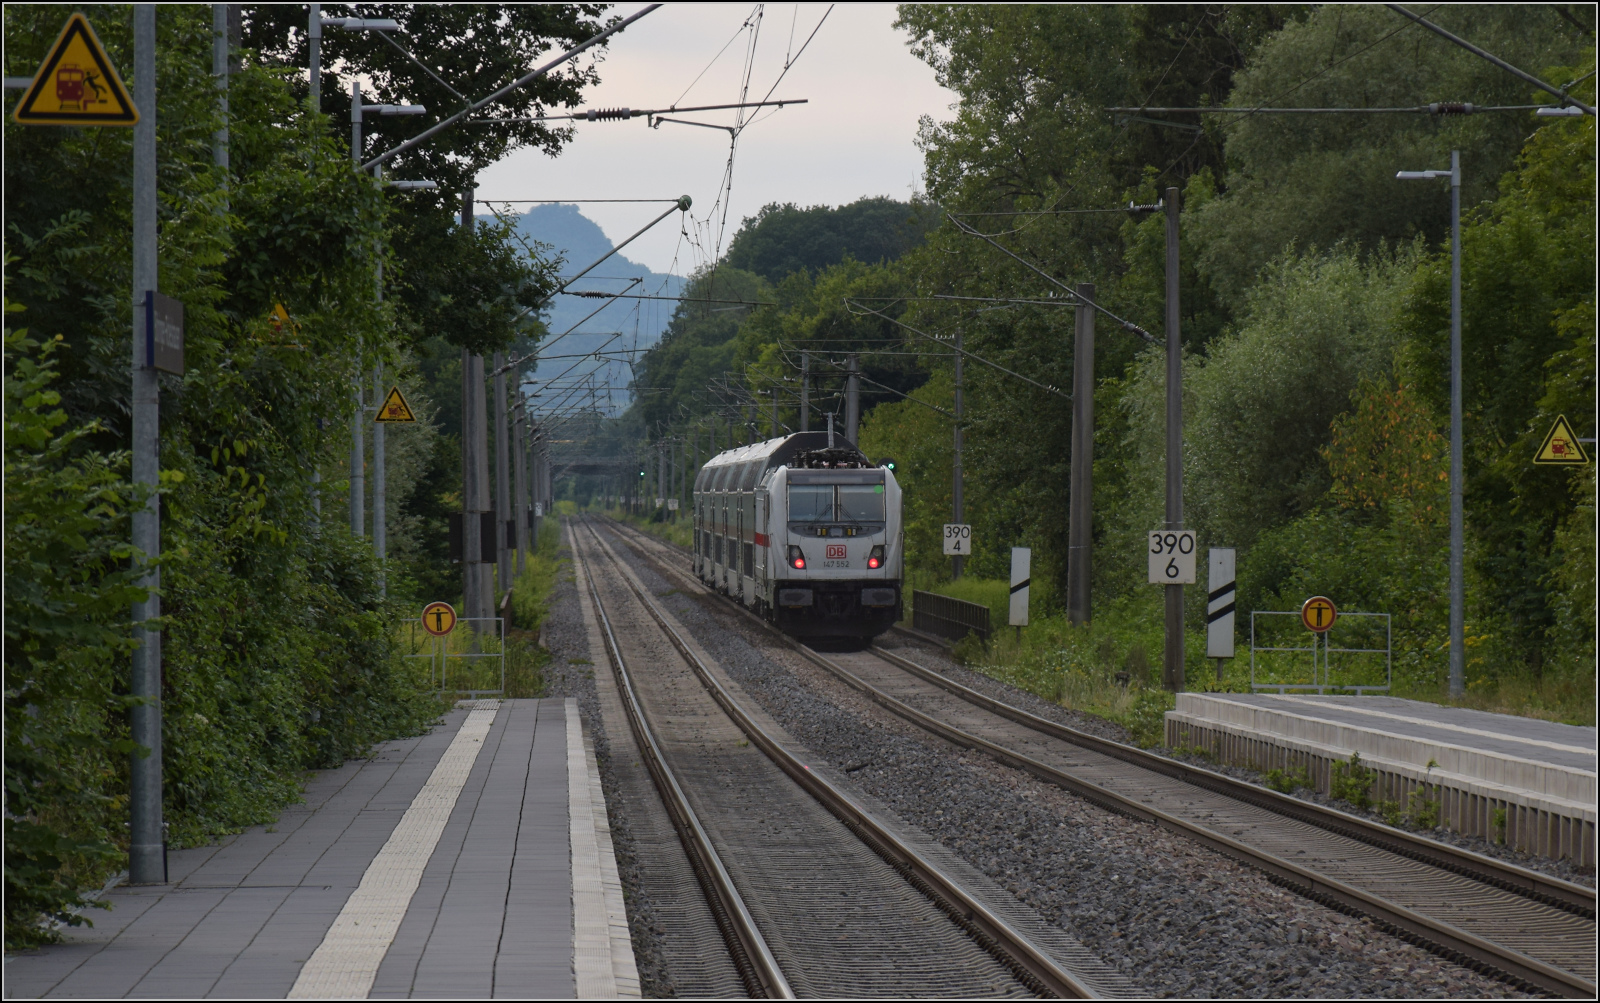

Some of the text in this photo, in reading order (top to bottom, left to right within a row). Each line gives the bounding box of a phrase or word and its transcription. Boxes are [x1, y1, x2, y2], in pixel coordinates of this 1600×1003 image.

[946, 526, 970, 538] 390
[953, 540, 961, 551] 4
[1151, 533, 1194, 554] 390
[828, 546, 845, 557] DB
[823, 560, 850, 568] 147 552
[1166, 557, 1180, 578] 6
